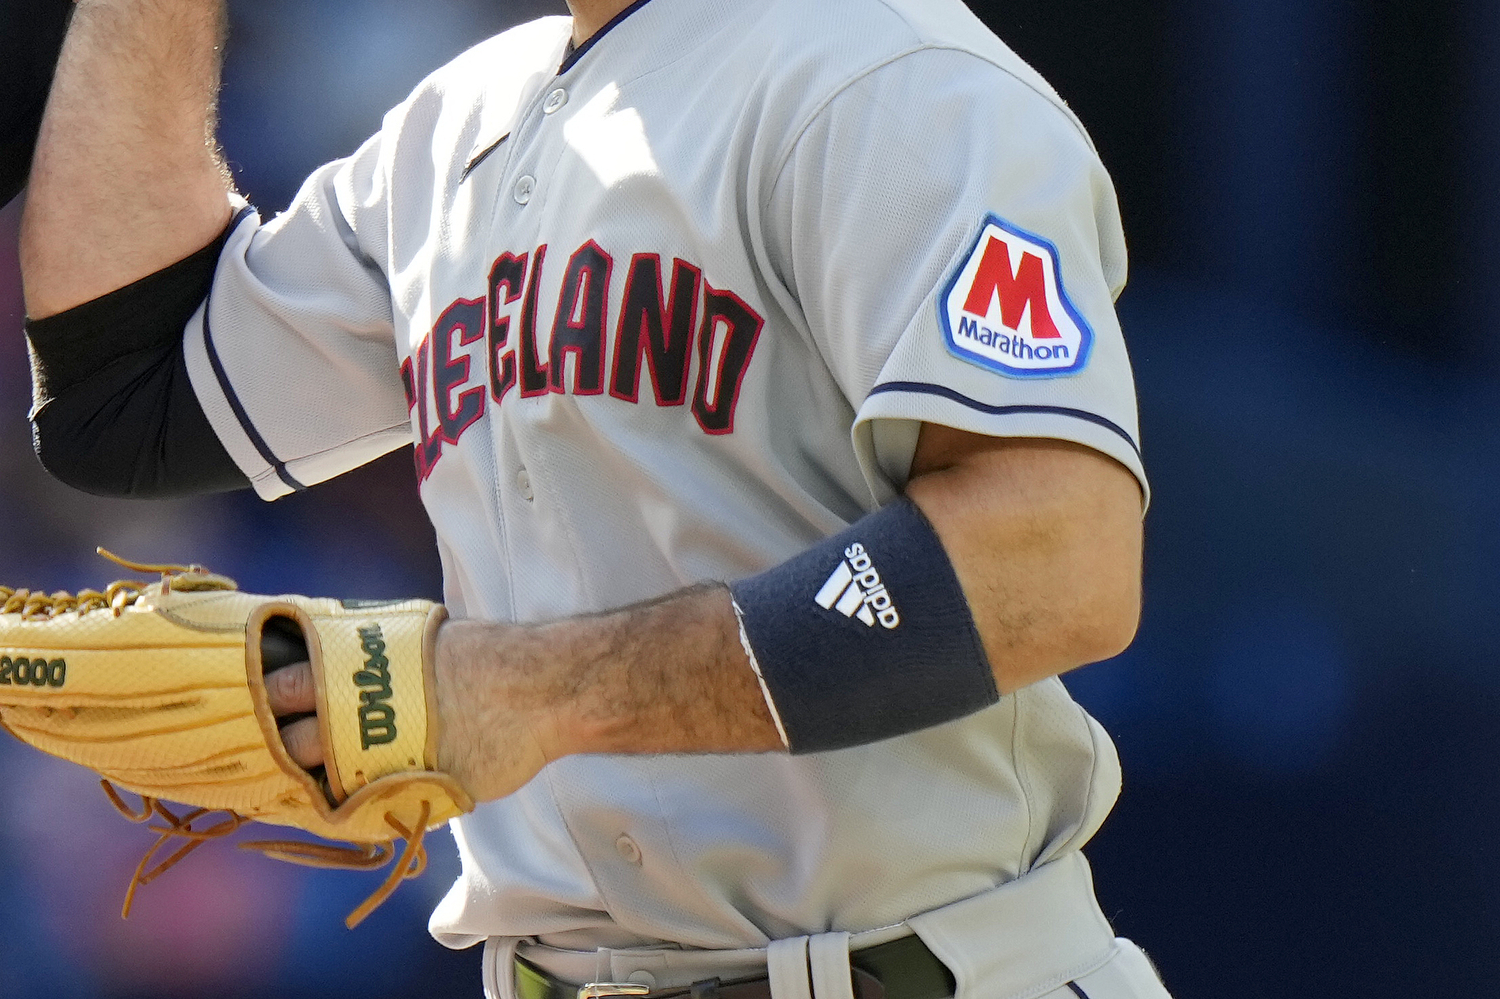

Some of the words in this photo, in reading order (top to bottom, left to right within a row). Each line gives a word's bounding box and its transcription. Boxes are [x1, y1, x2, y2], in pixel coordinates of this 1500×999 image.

[957, 315, 1070, 361] Marathon
[844, 542, 900, 629] adidas
[352, 622, 398, 751] Wilson
